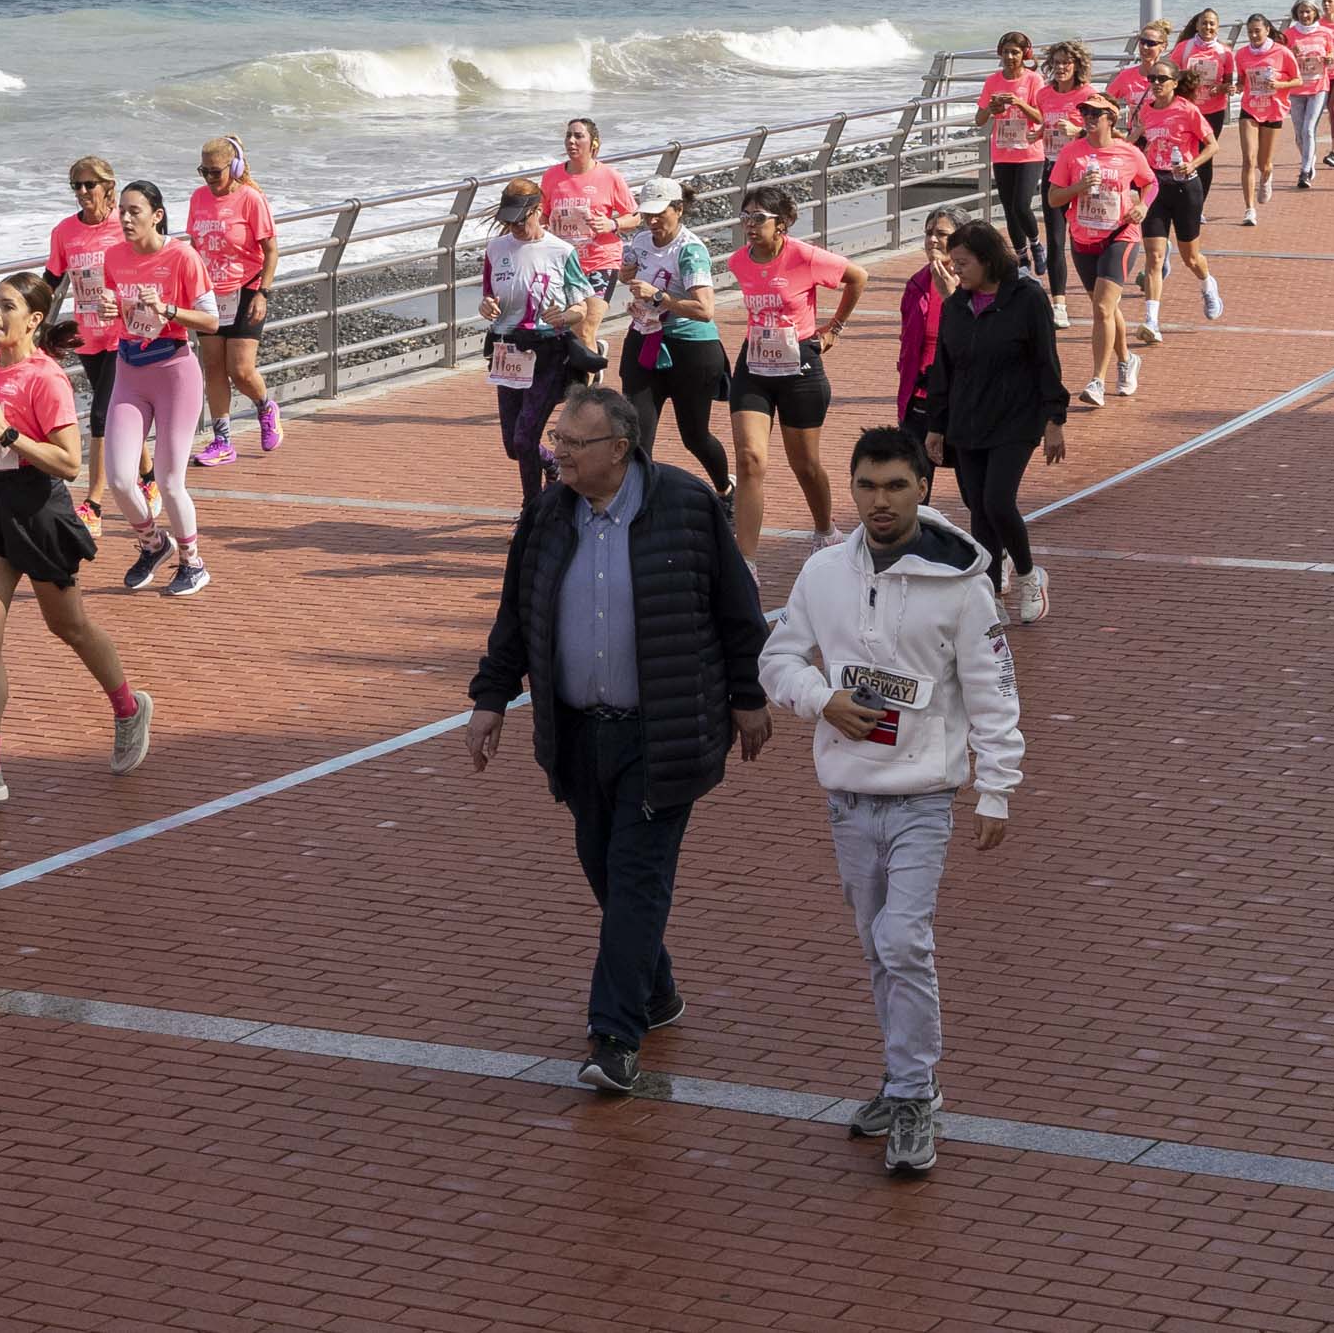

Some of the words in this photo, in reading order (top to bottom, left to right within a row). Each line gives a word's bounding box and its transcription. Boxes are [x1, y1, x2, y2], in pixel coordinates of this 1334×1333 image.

[1090, 207, 1107, 215] 016
[562, 224, 578, 232] 016
[69, 250, 106, 267] CARRER
[84, 286, 104, 298] 016
[132, 321, 152, 332] 016
[762, 349, 783, 359] 016
[505, 363, 522, 373] 016
[843, 666, 912, 701] NORWAY
